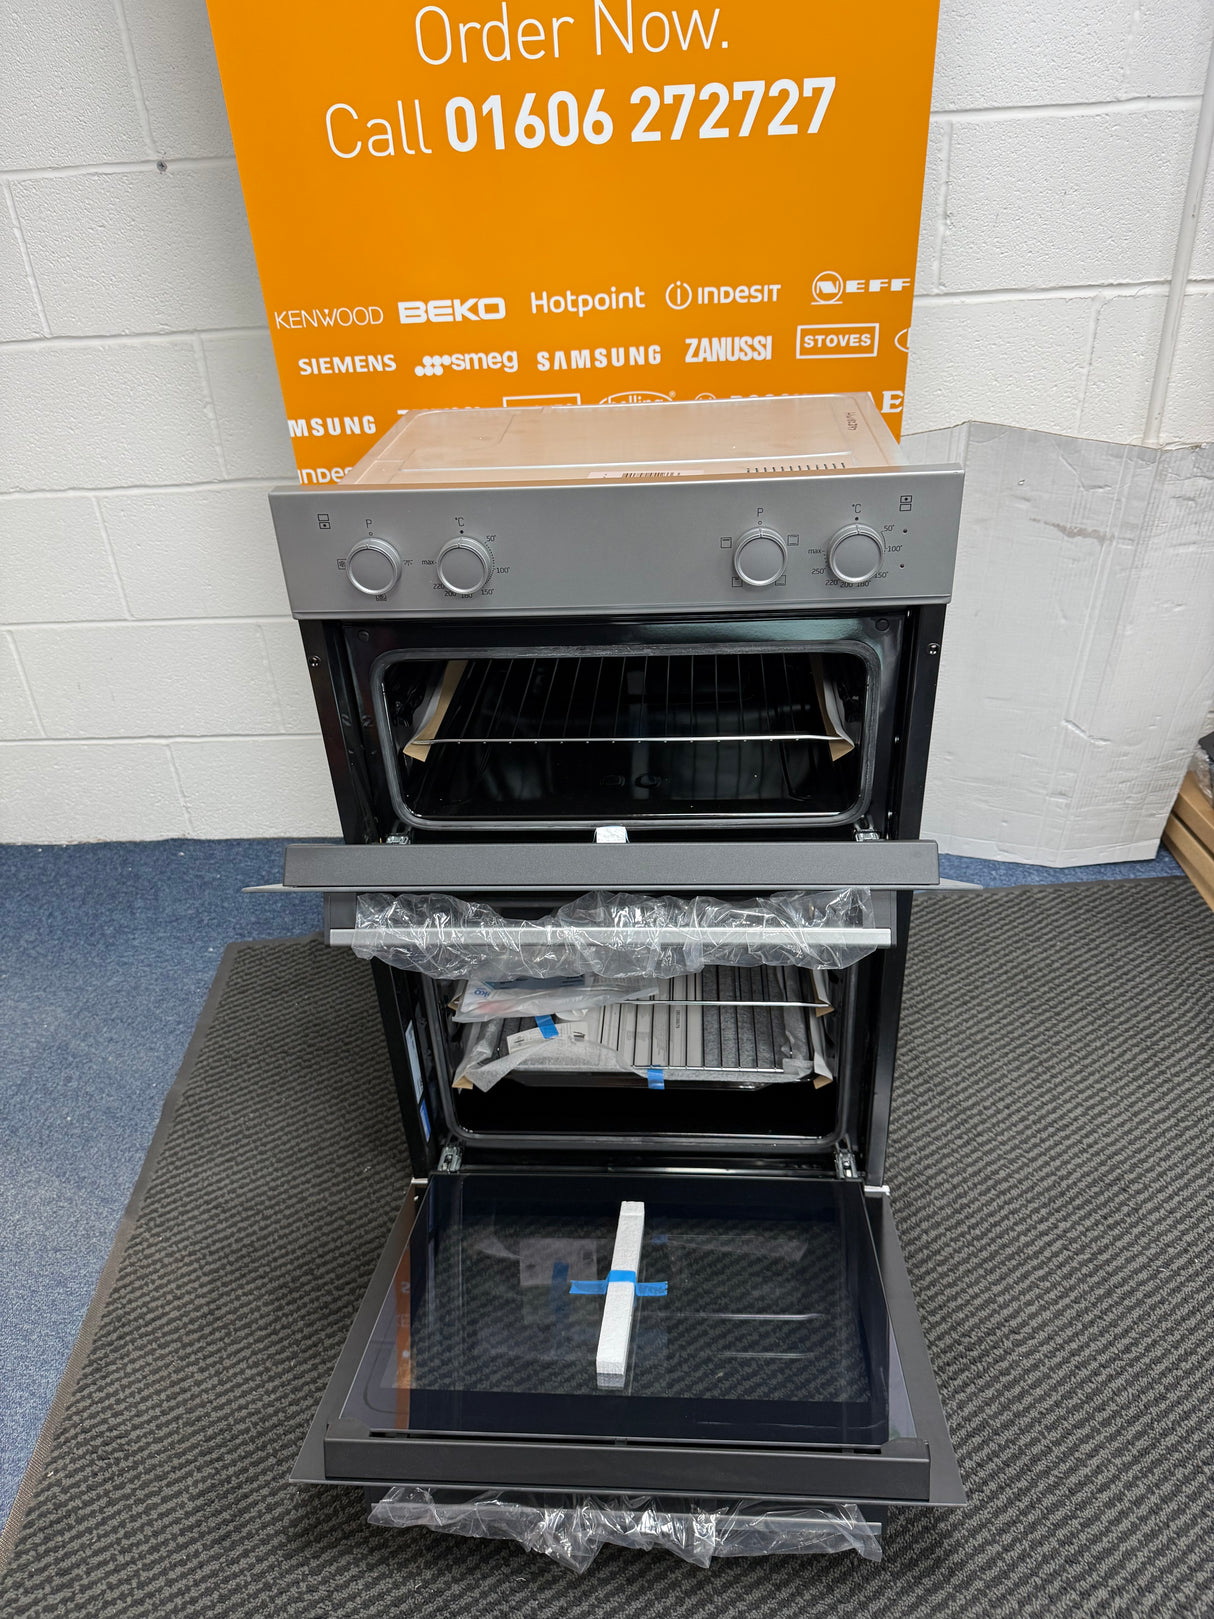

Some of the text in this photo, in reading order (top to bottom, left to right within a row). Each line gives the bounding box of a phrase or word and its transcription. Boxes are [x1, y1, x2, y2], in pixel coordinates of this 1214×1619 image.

[415, 0, 729, 65] Order Now.
[325, 77, 836, 158] Call 01606 272727
[398, 297, 506, 324] BEKO
[530, 286, 646, 317] Hotpoint
[274, 306, 384, 329] KENWOOD
[685, 336, 773, 363] ZANUSSI
[803, 333, 872, 348] STOVES
[298, 354, 397, 375] SIEMENS
[450, 350, 518, 373] smeg
[536, 345, 662, 371] SAMSUNG
[365, 519, 373, 529] P
[756, 507, 764, 518] P
